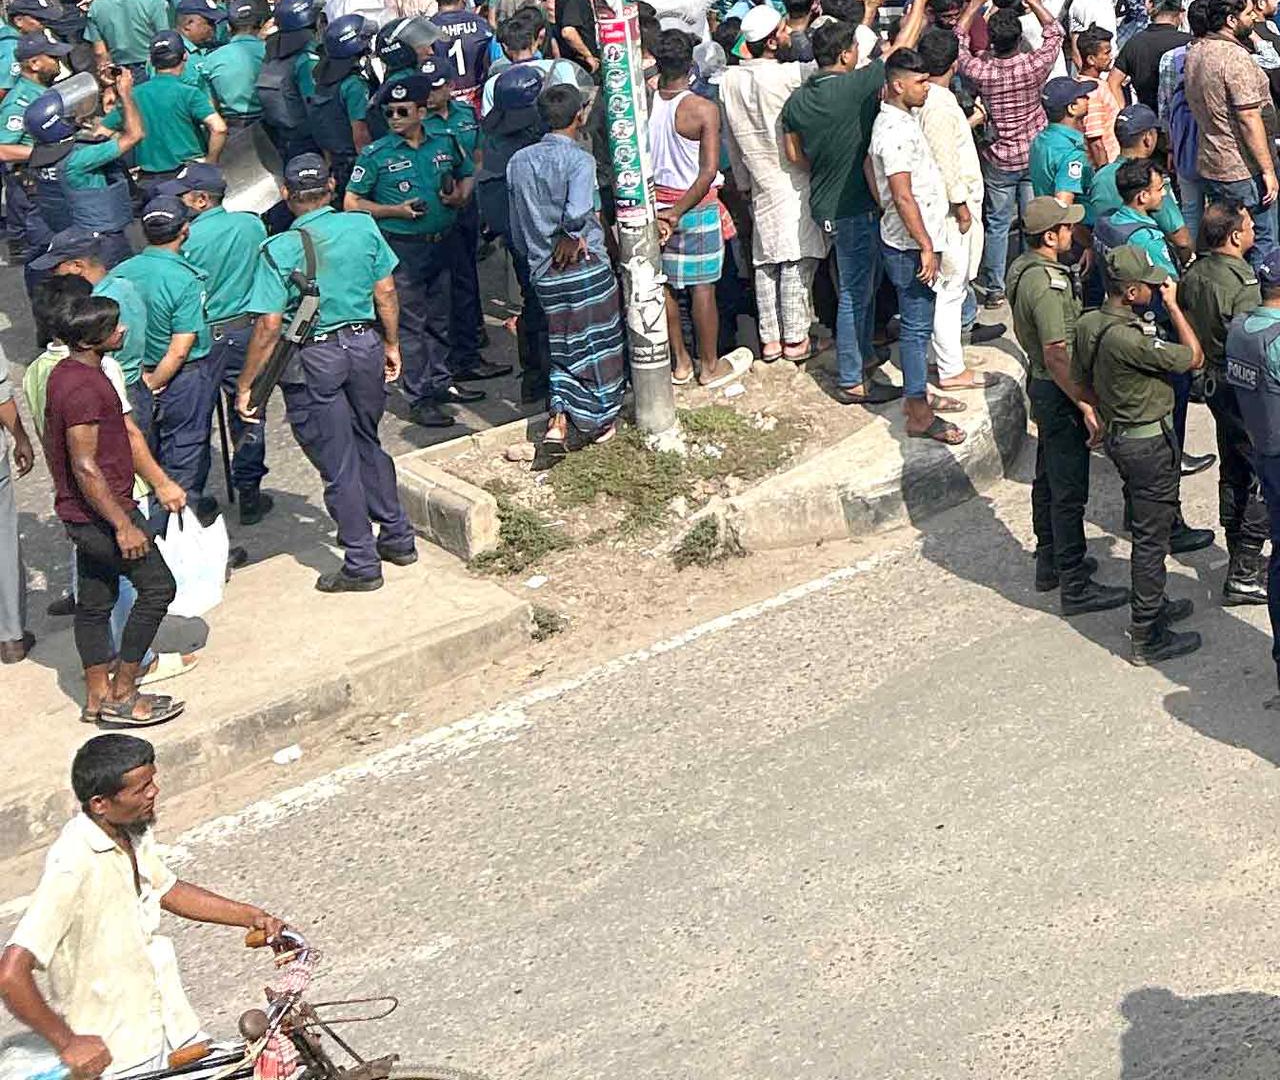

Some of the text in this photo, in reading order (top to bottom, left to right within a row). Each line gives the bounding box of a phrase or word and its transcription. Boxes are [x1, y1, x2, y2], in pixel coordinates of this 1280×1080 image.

[441, 22, 478, 37] AHFUJ
[447, 38, 466, 76] 1
[1228, 361, 1257, 384] POLICE
